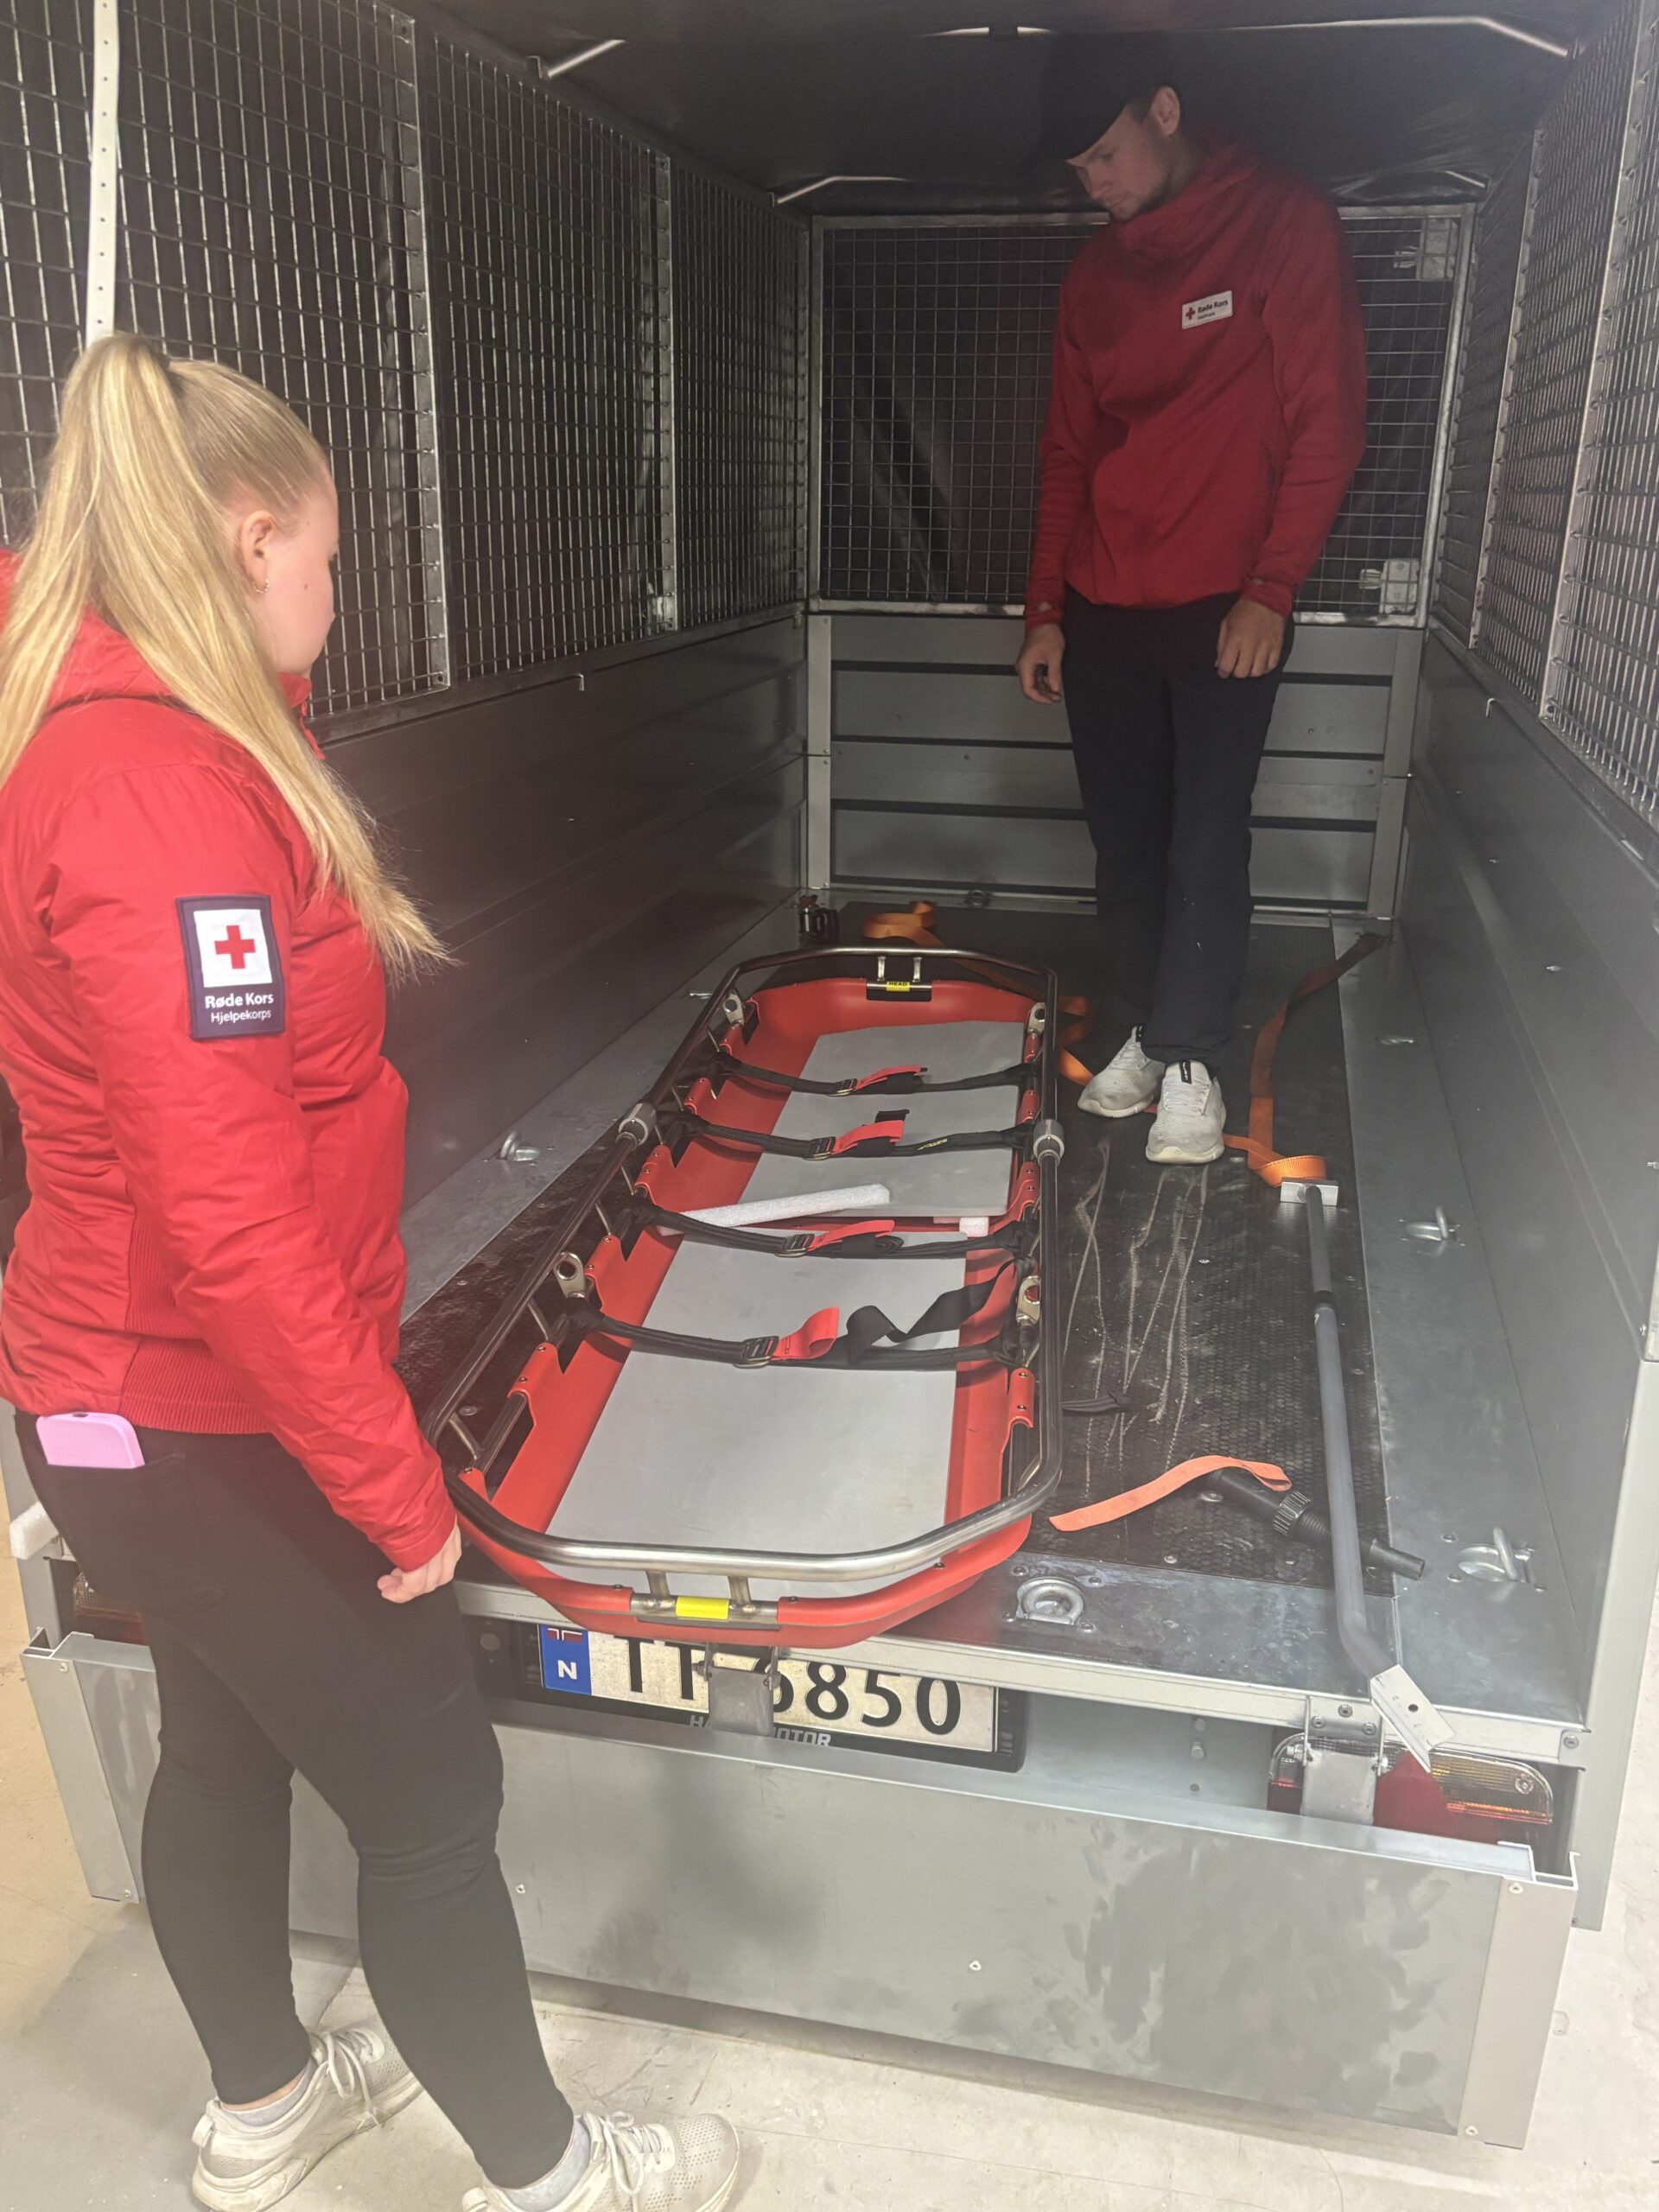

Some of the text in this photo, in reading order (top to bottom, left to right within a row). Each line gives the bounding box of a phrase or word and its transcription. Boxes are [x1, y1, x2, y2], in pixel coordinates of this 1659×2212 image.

[1214, 300, 1228, 308] Kors
[205, 992, 274, 1009] Røde Kors
[211, 1010, 271, 1025] Hjelpekorps
[557, 1659, 577, 1680] N
[772, 1726, 831, 1746] OTOR
